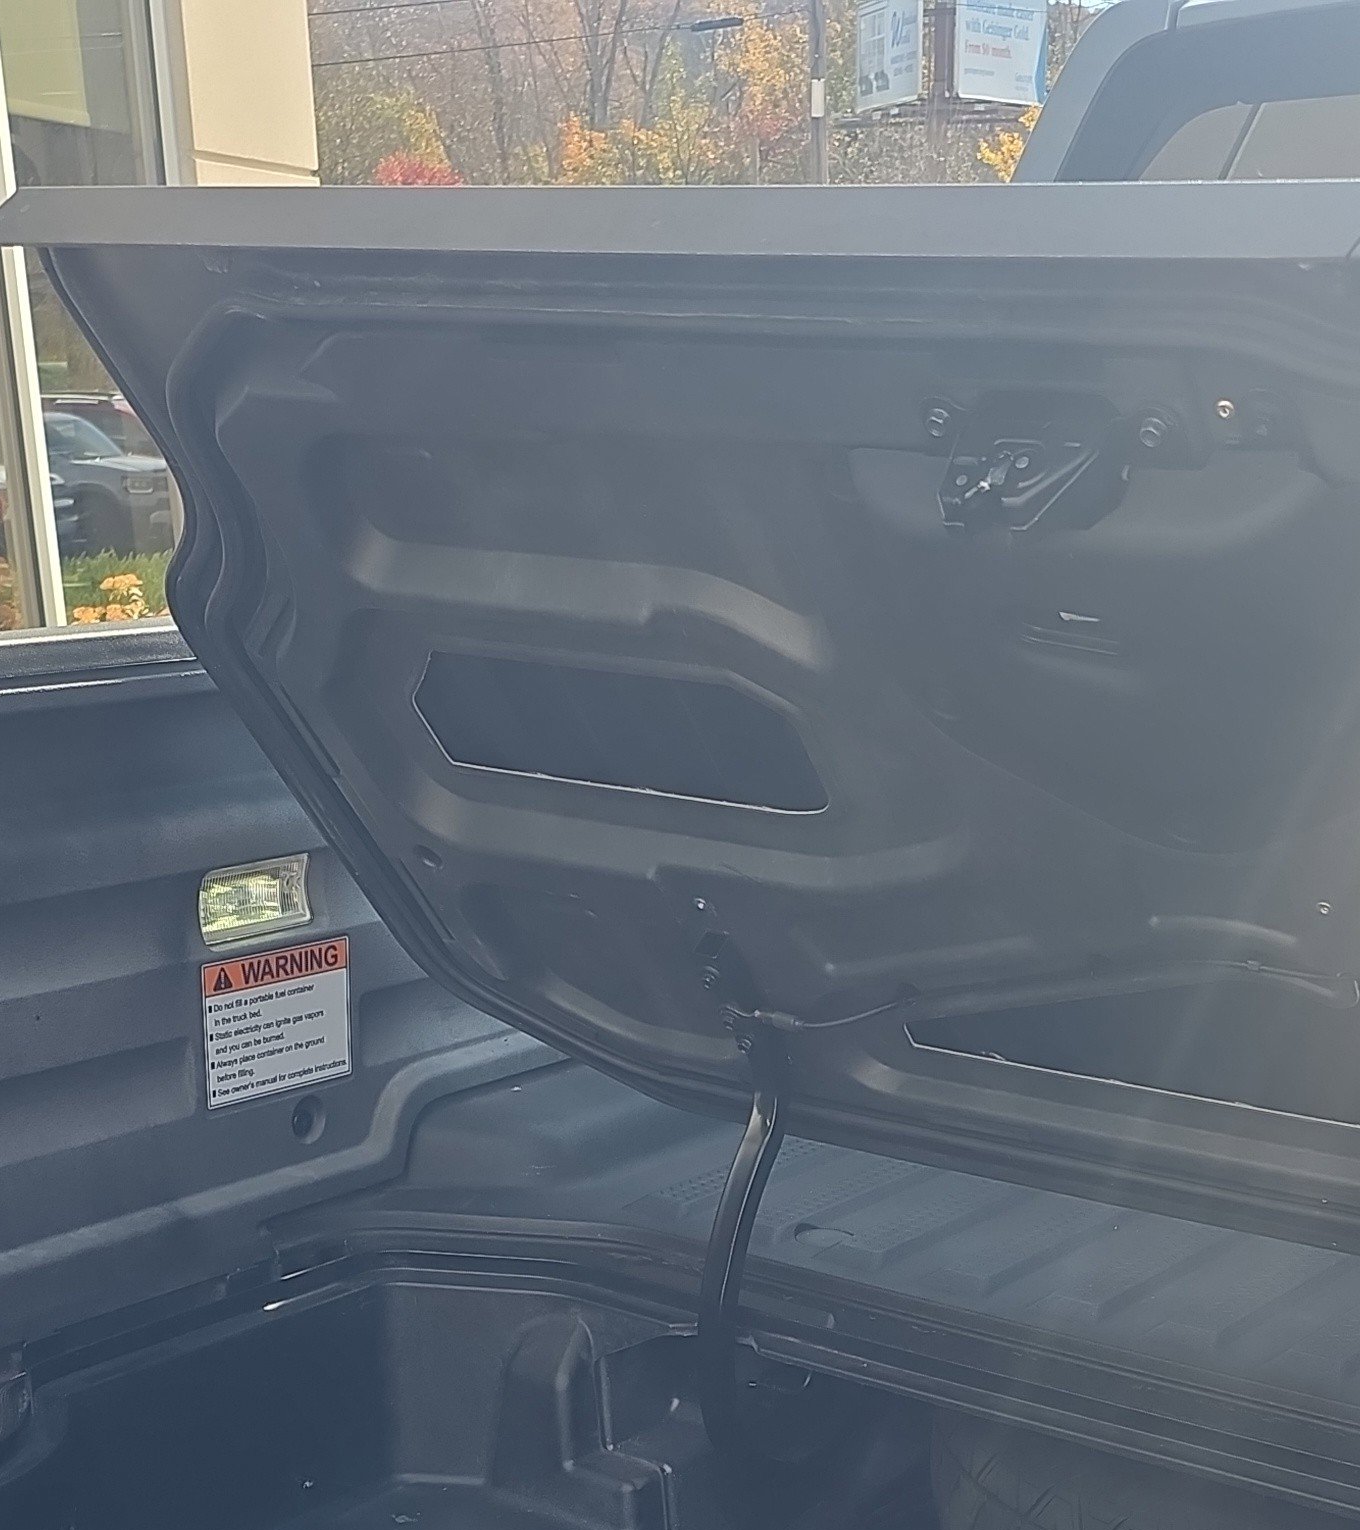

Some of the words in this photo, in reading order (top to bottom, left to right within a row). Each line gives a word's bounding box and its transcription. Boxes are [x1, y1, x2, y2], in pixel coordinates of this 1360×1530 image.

[241, 945, 338, 984] WARNING
[214, 1004, 222, 1012] Do
[224, 1001, 234, 1010] not
[249, 992, 273, 1005] portable
[275, 989, 285, 998] fuel
[287, 984, 314, 996] container
[215, 1031, 232, 1041] Static
[234, 1024, 262, 1037] electricity
[263, 1021, 274, 1030] can
[275, 1016, 291, 1027] ignite
[292, 1015, 303, 1025] gas
[305, 1010, 324, 1022] vapors
[222, 1014, 231, 1025] the
[233, 1012, 247, 1022] truck
[249, 1009, 262, 1018] bed.
[216, 1046, 227, 1055] and
[229, 1043, 240, 1054] you
[241, 1040, 252, 1049] can
[253, 1037, 261, 1045] be
[263, 1032, 285, 1044] burned.
[216, 1057, 238, 1069] Always
[239, 1054, 255, 1065] place
[257, 1047, 284, 1059] container
[285, 1044, 293, 1052] on
[294, 1041, 303, 1050] the
[305, 1036, 325, 1049] ground
[217, 1073, 236, 1082] before
[218, 1088, 229, 1097] See
[231, 1082, 255, 1094] owner's
[256, 1075, 277, 1088] manual
[288, 1067, 313, 1080] complete
[315, 1059, 347, 1073] instructions.
